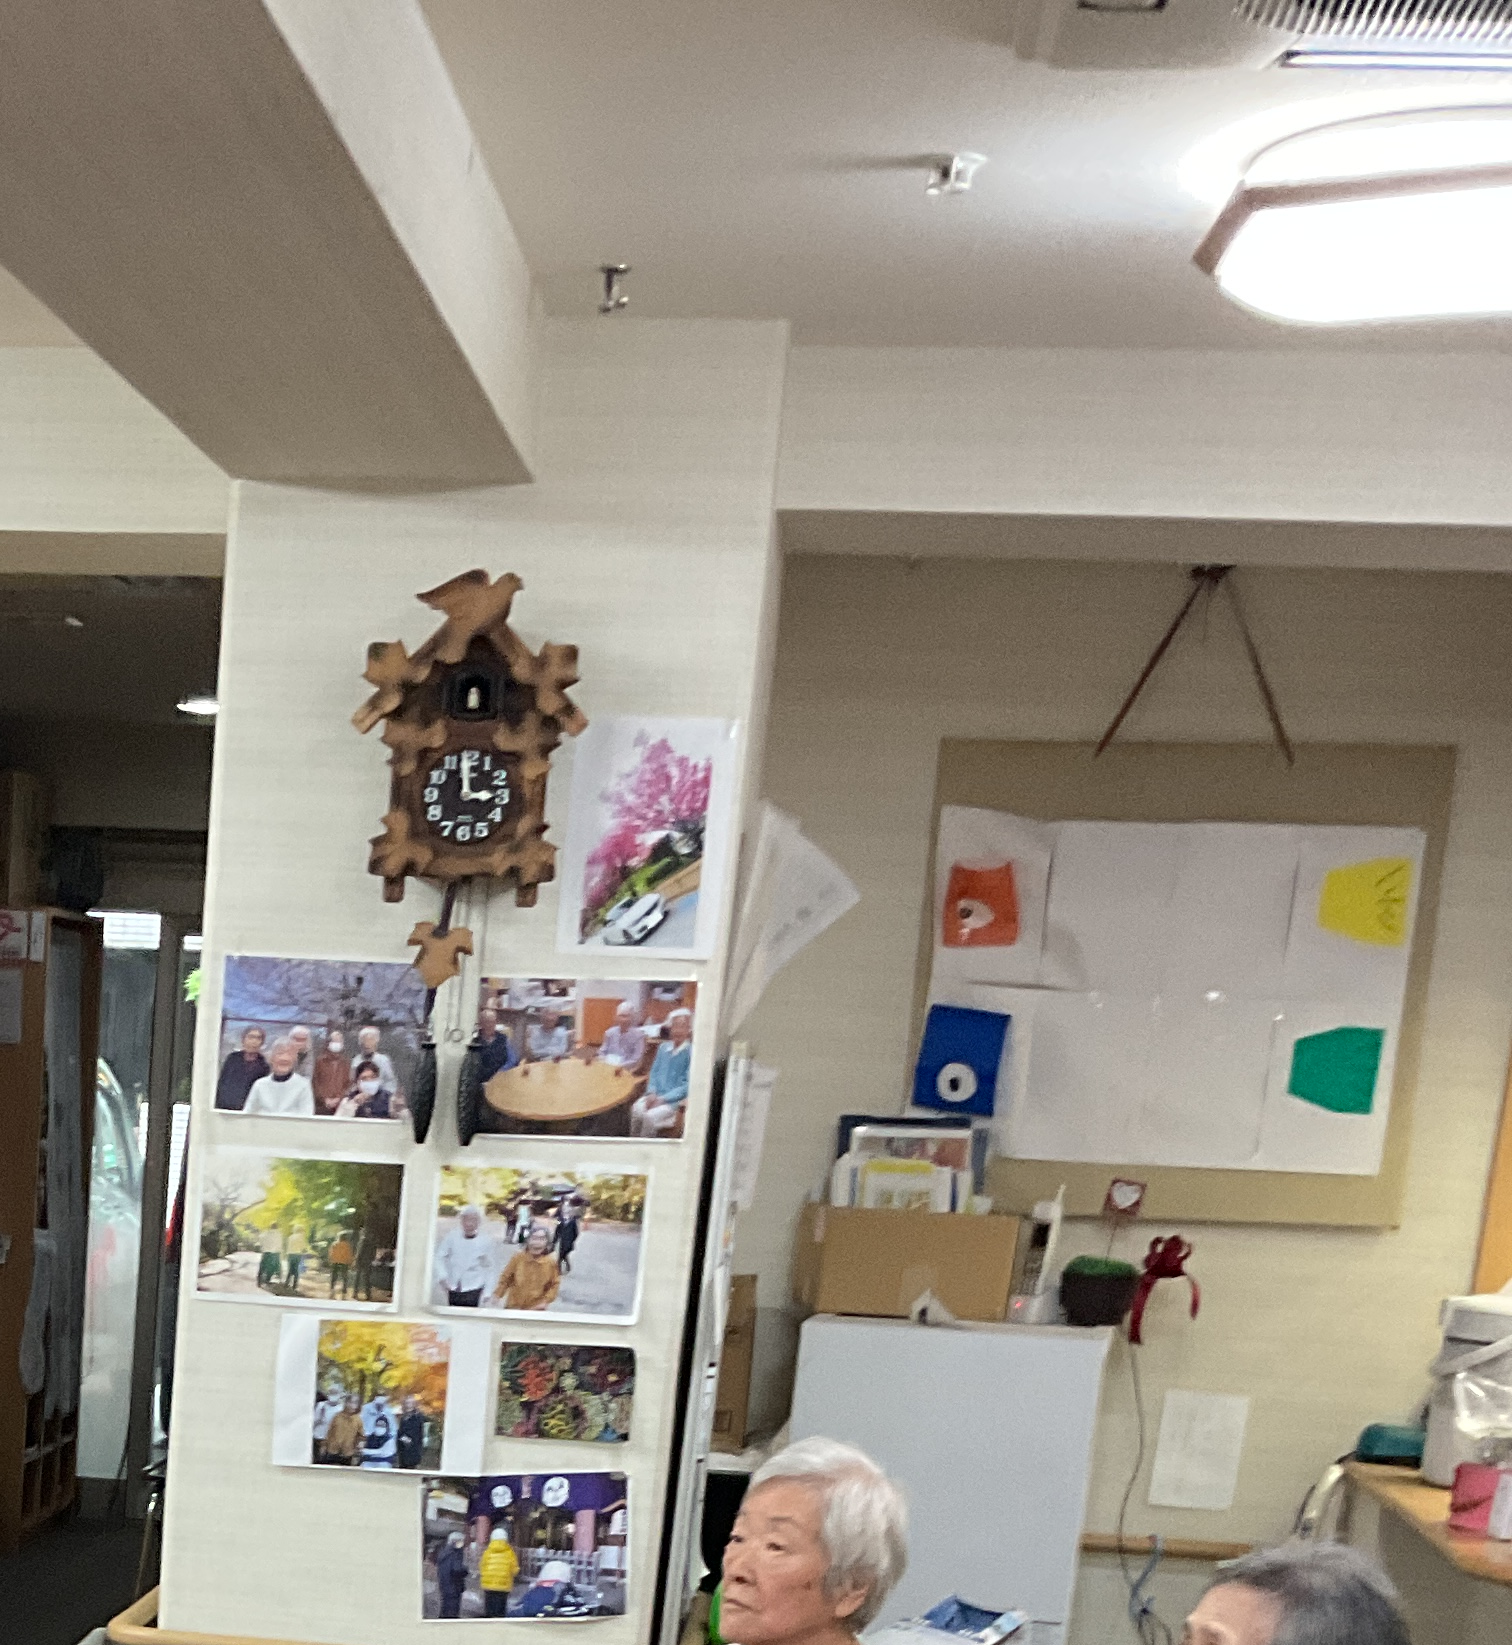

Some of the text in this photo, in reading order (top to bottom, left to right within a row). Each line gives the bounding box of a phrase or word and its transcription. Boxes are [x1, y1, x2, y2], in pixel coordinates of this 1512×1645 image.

[483, 755, 492, 771] 1
[492, 769, 507, 786] 2
[423, 787, 439, 803] 9
[494, 788, 510, 805] 3
[427, 804, 443, 821] 8
[487, 807, 502, 822] 4
[439, 821, 455, 837] 7
[456, 825, 471, 841] 6
[474, 822, 489, 838] 5
